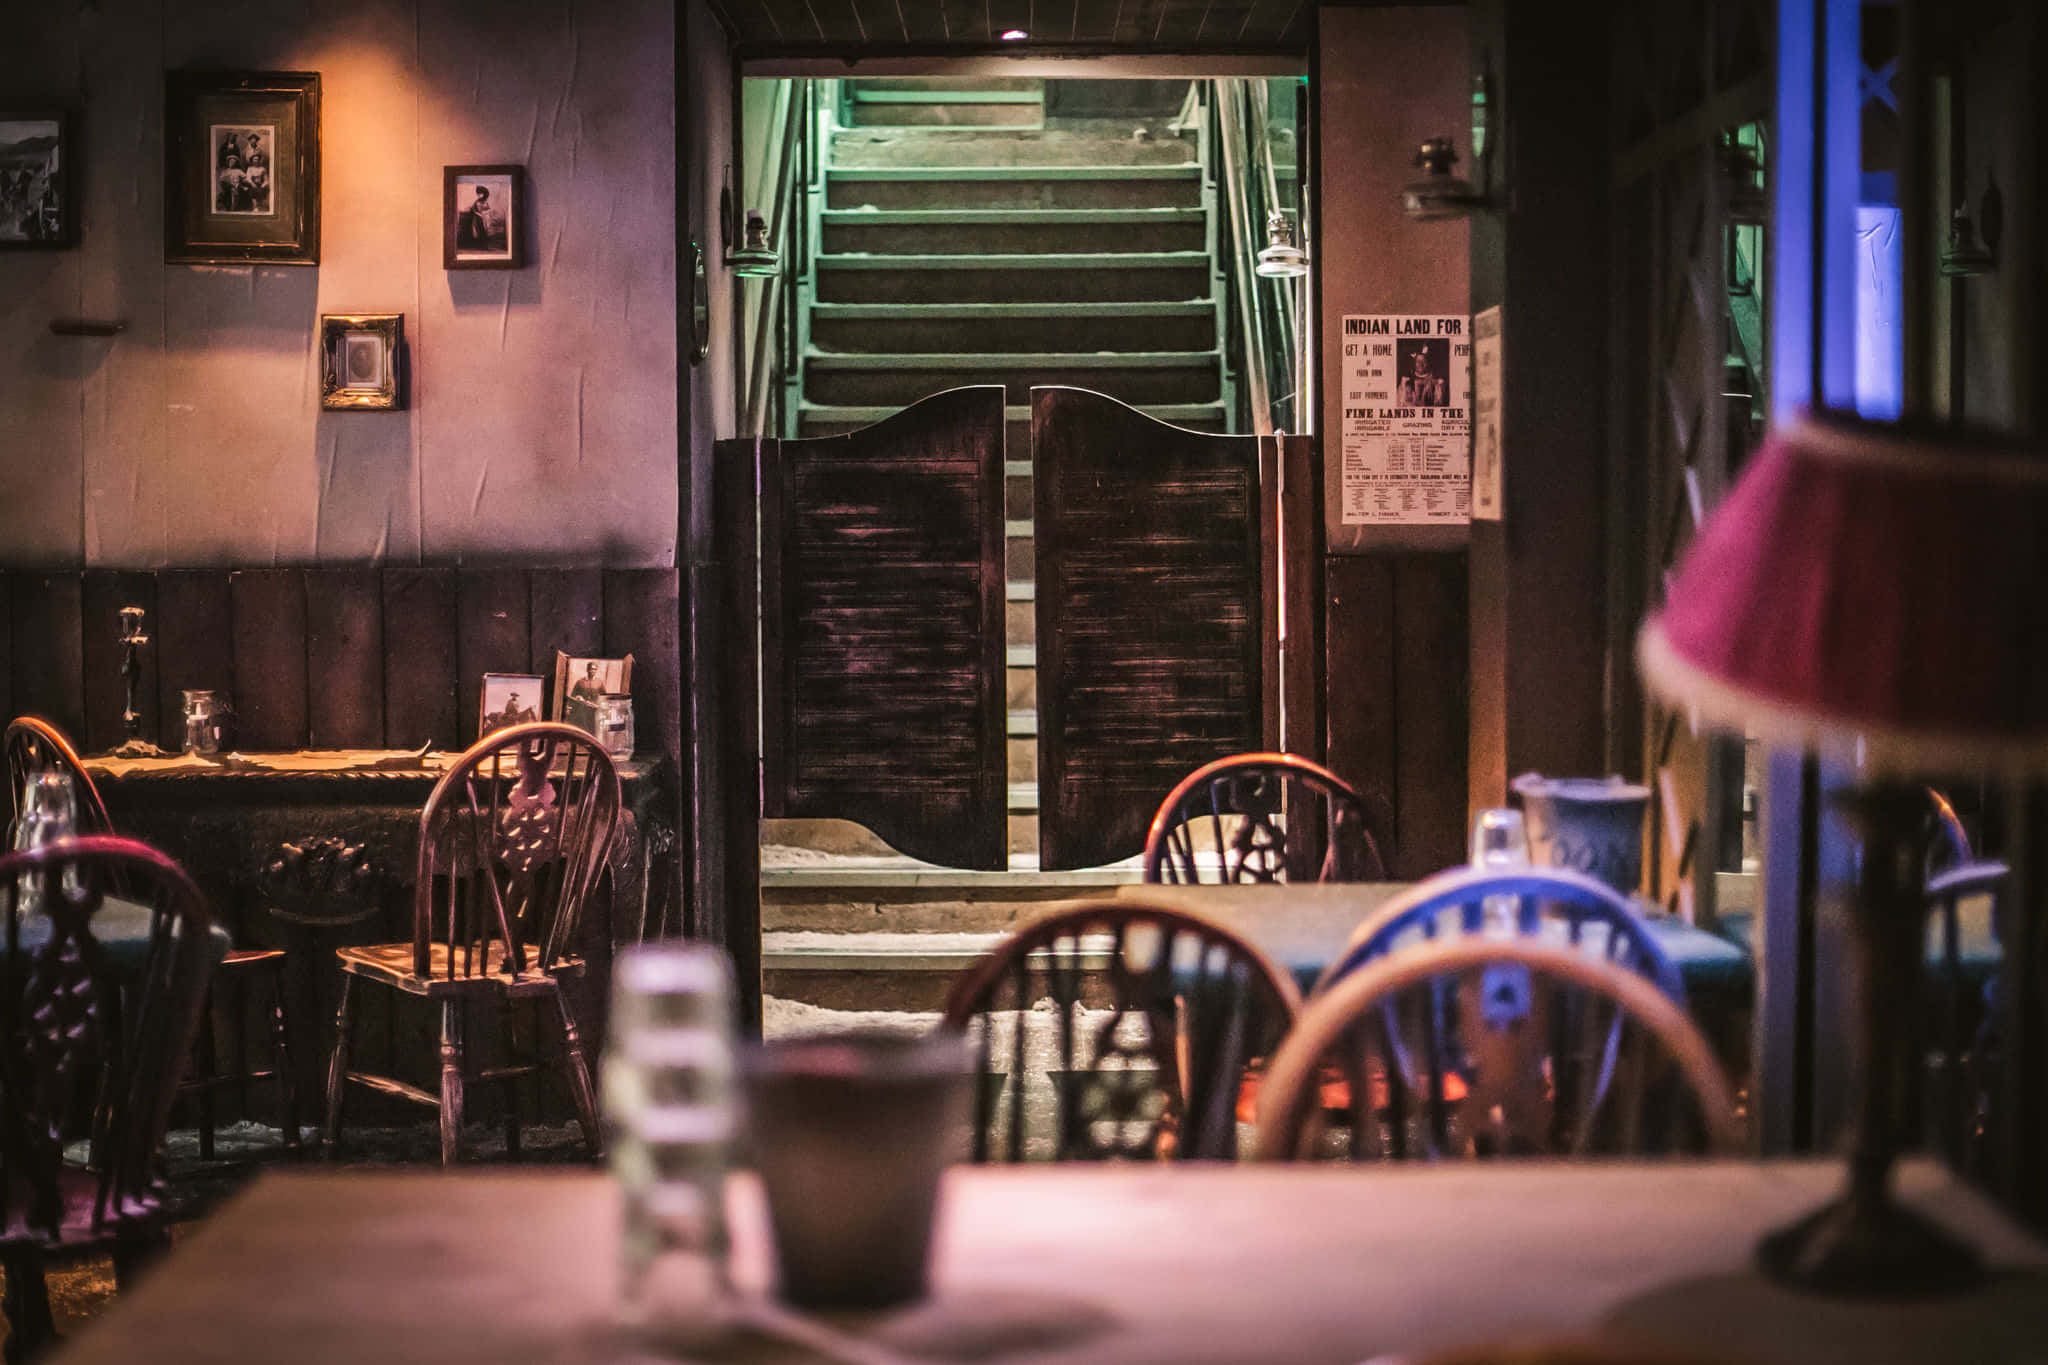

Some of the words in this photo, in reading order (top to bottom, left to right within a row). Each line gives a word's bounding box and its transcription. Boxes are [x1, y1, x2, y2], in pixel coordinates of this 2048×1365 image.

[1345, 319, 1389, 334] INDIAN
[1396, 319, 1430, 334] LAND
[1437, 319, 1461, 334] FOR
[1345, 344, 1358, 356] GET
[1363, 344, 1368, 356] A
[1373, 344, 1392, 356] HOME
[1345, 409, 1373, 418] FINE
[1379, 409, 1415, 418] LANDS
[1422, 409, 1434, 418] IN
[1440, 409, 1463, 418] THE
